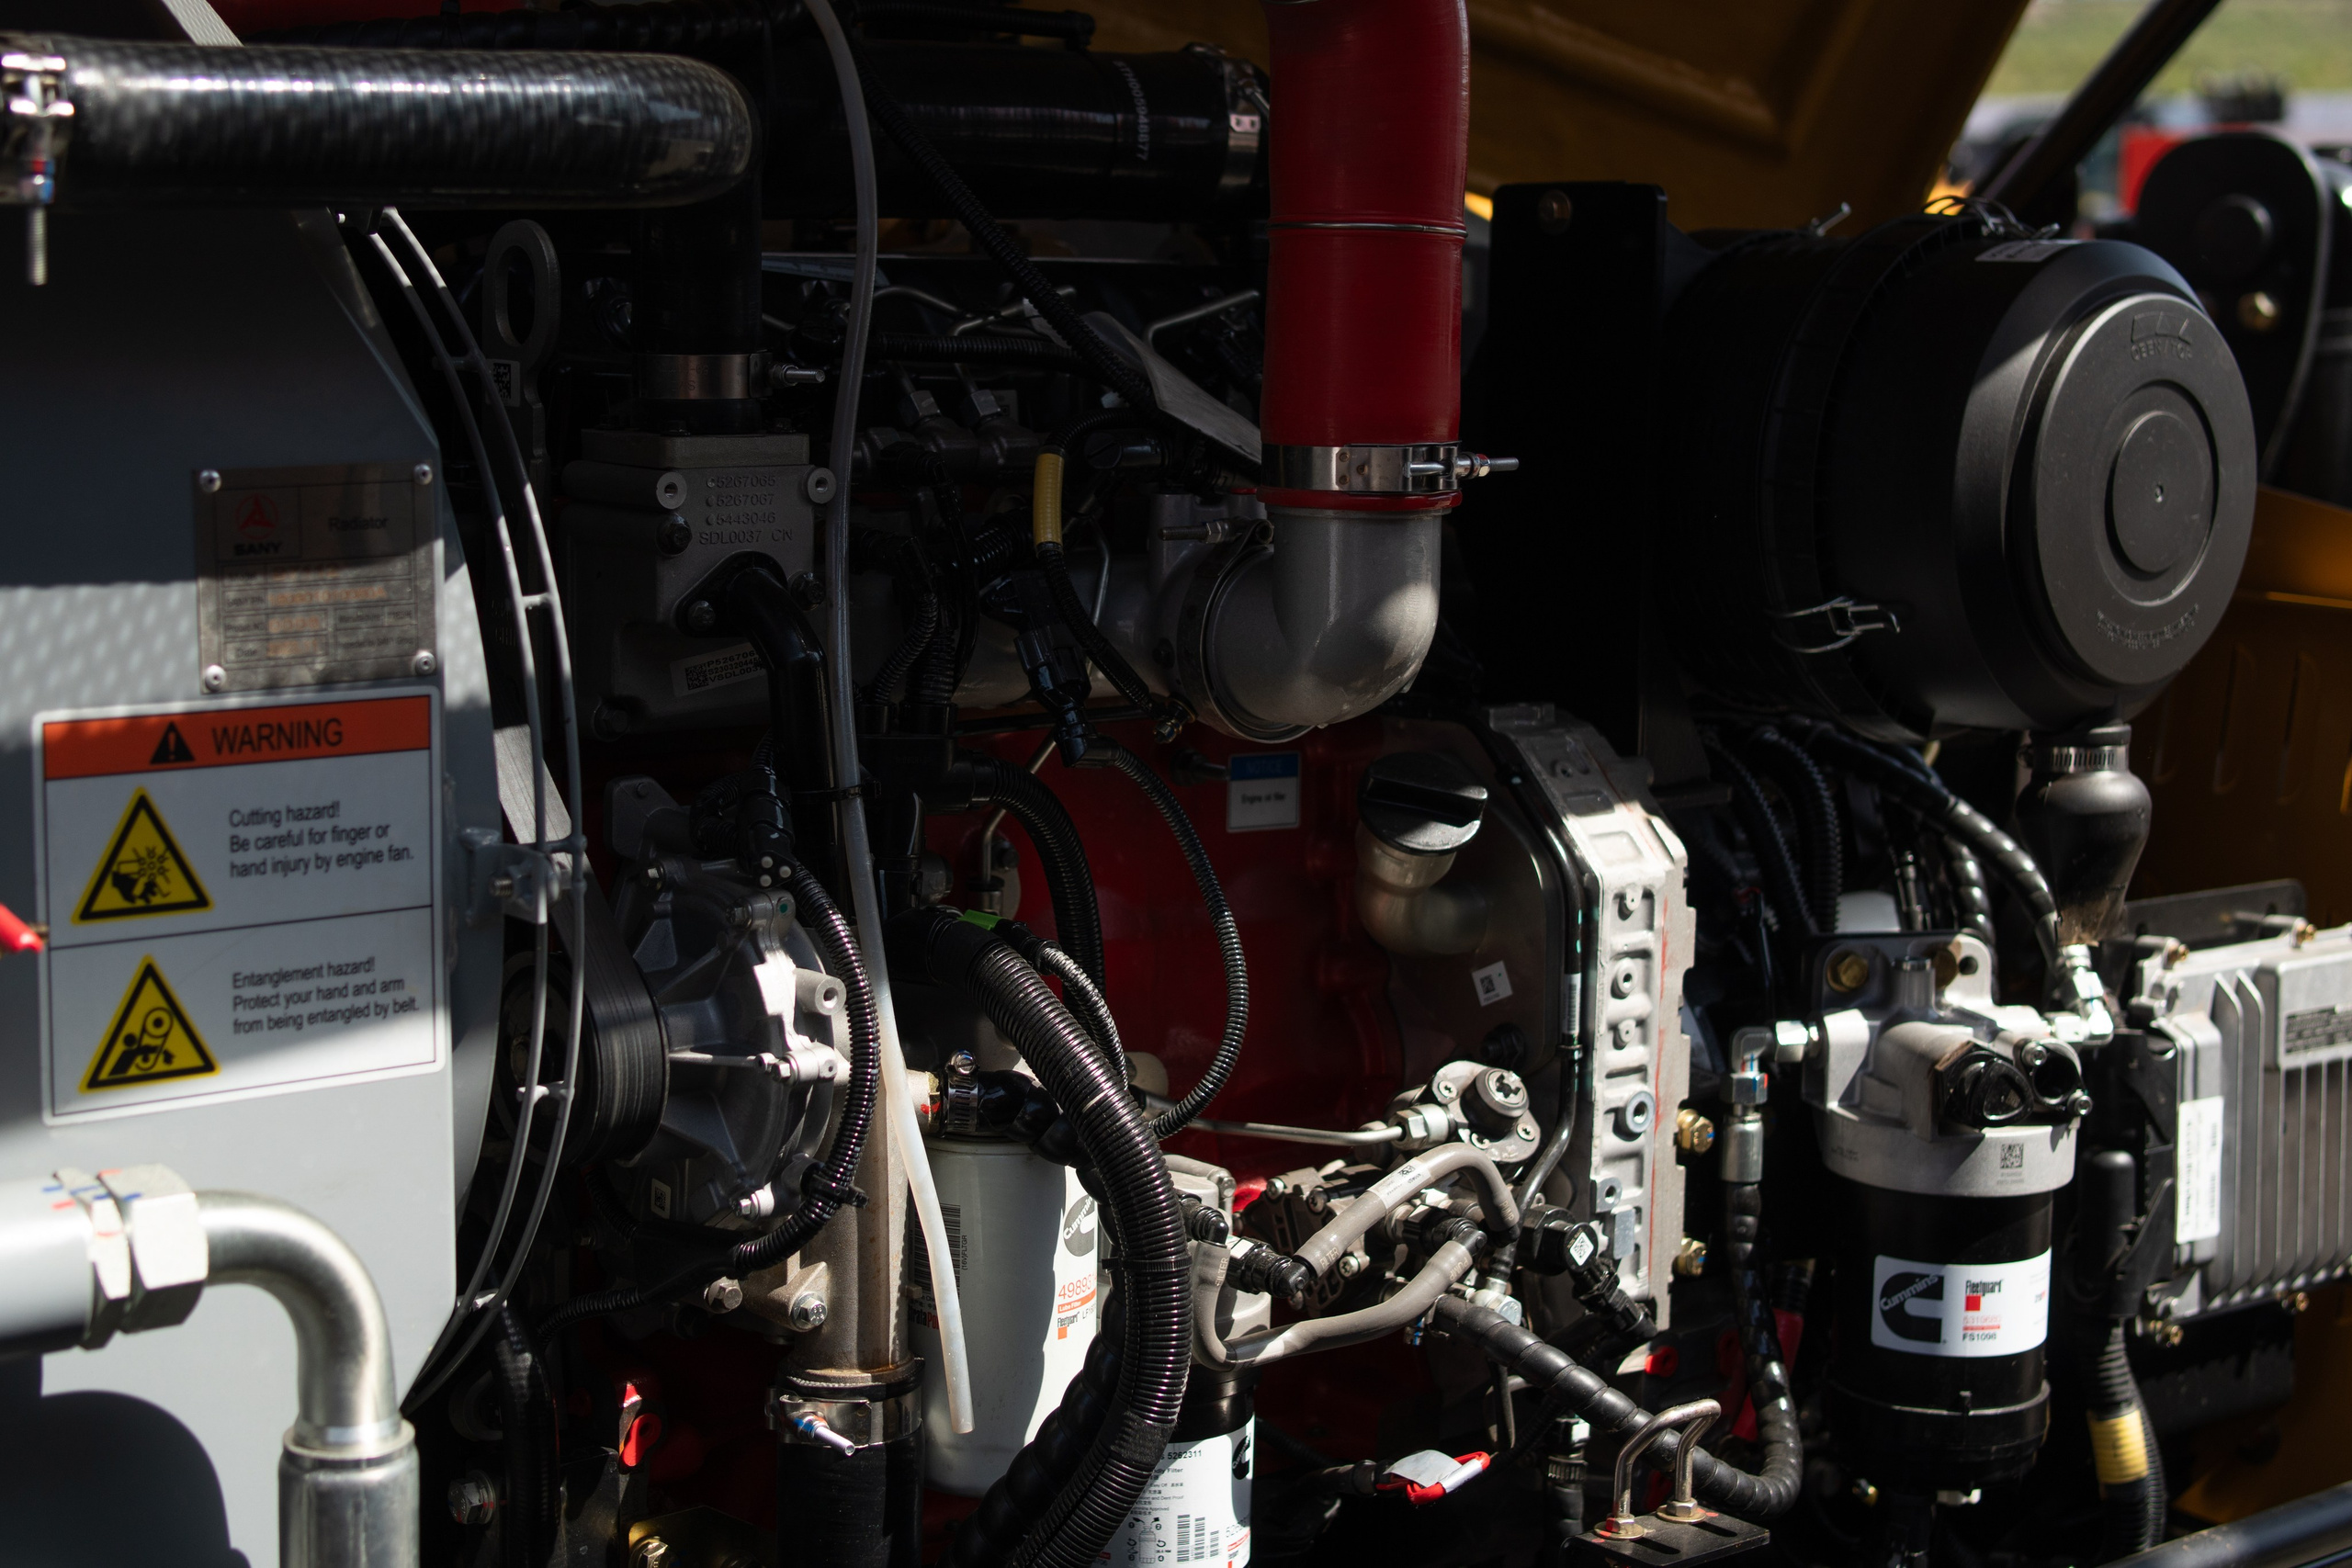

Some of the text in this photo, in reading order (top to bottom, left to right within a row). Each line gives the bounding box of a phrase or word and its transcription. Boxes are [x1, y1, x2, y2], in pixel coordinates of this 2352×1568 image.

[329, 516, 389, 531] Radiator
[234, 541, 283, 556] SANY
[699, 529, 793, 545] SDL0037 CN
[707, 649, 757, 668] P526706
[212, 718, 343, 755] WARNING
[230, 801, 341, 827] Cutting hazard!
[230, 825, 391, 852] Be careful for finger or
[231, 845, 414, 877] hand injury by engine fan.
[233, 957, 375, 989] Entanglement hazard!
[233, 977, 405, 1011] Protect your hand and arm
[233, 997, 419, 1034] from being entangled by belt.
[1063, 1195, 1093, 1240] Cummin
[1499, 1201, 1514, 1221] PUMP
[1319, 1247, 1340, 1269] FILTER
[1449, 1258, 1468, 1281] PUMP
[1215, 1257, 1228, 1286] FILTER
[1880, 1274, 1939, 1312] Cummins
[1965, 1280, 2003, 1296] Fleetguard
[1059, 1301, 1081, 1312] Lube Filter
[1168, 1450, 1202, 1460] 5262311
